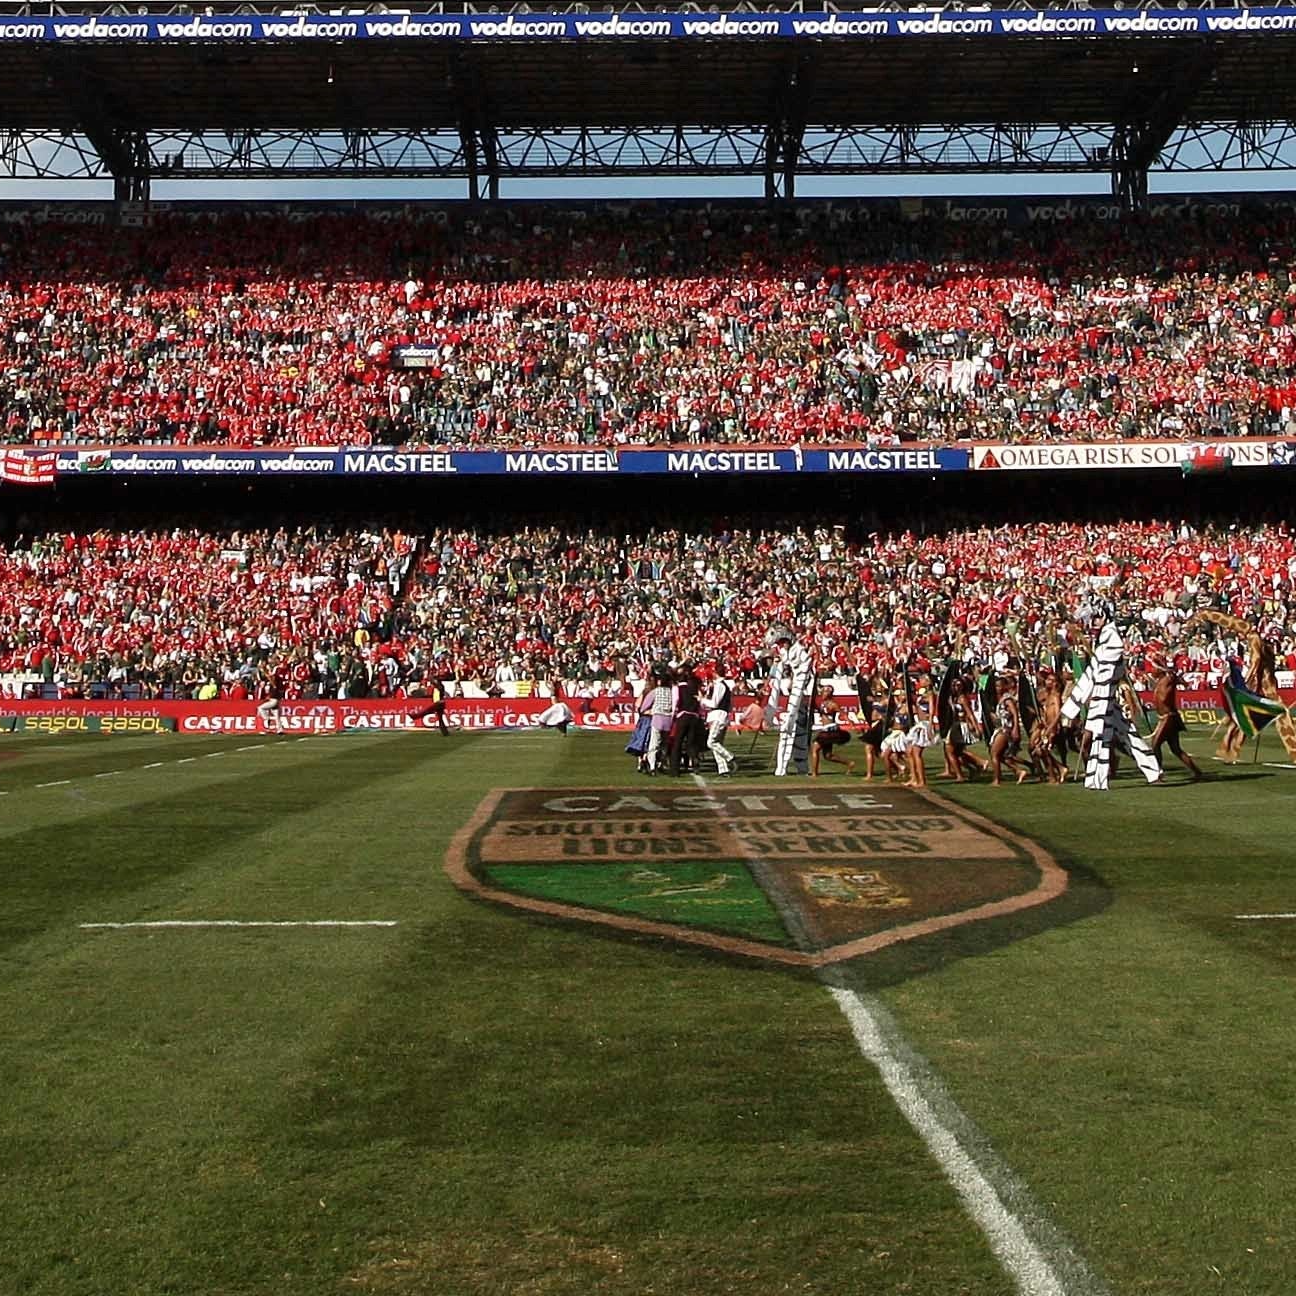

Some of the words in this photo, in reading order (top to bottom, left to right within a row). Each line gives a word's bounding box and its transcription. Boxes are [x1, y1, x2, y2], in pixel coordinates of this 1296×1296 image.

[54, 18, 148, 37] vodacom
[157, 17, 252, 37] vodacom
[262, 17, 356, 36] vodacom
[366, 16, 460, 36] vodacom
[471, 16, 565, 35] vodacom
[575, 15, 670, 35] vodacom
[683, 15, 778, 34] vodacom
[793, 15, 888, 34] vodacom
[897, 14, 992, 33] vodacom
[1001, 12, 1095, 31] vodacom
[1104, 11, 1198, 31] vodacom
[183, 454, 255, 471] vodacom
[261, 454, 334, 471] vodacom
[344, 454, 456, 471] MACSTEEL
[668, 452, 780, 470] MACSTEEL
[828, 450, 940, 469] MACSTEEL
[1001, 448, 1077, 466] OMEGA
[1085, 447, 1134, 464] RISK
[1181, 698, 1217, 710] bank
[184, 716, 257, 730] CASTLE
[343, 714, 415, 728] CASTLE
[543, 793, 893, 812] CASTLE
[841, 817, 954, 832] 2009
[562, 836, 722, 855] LIONS
[738, 834, 933, 854] SERIES
